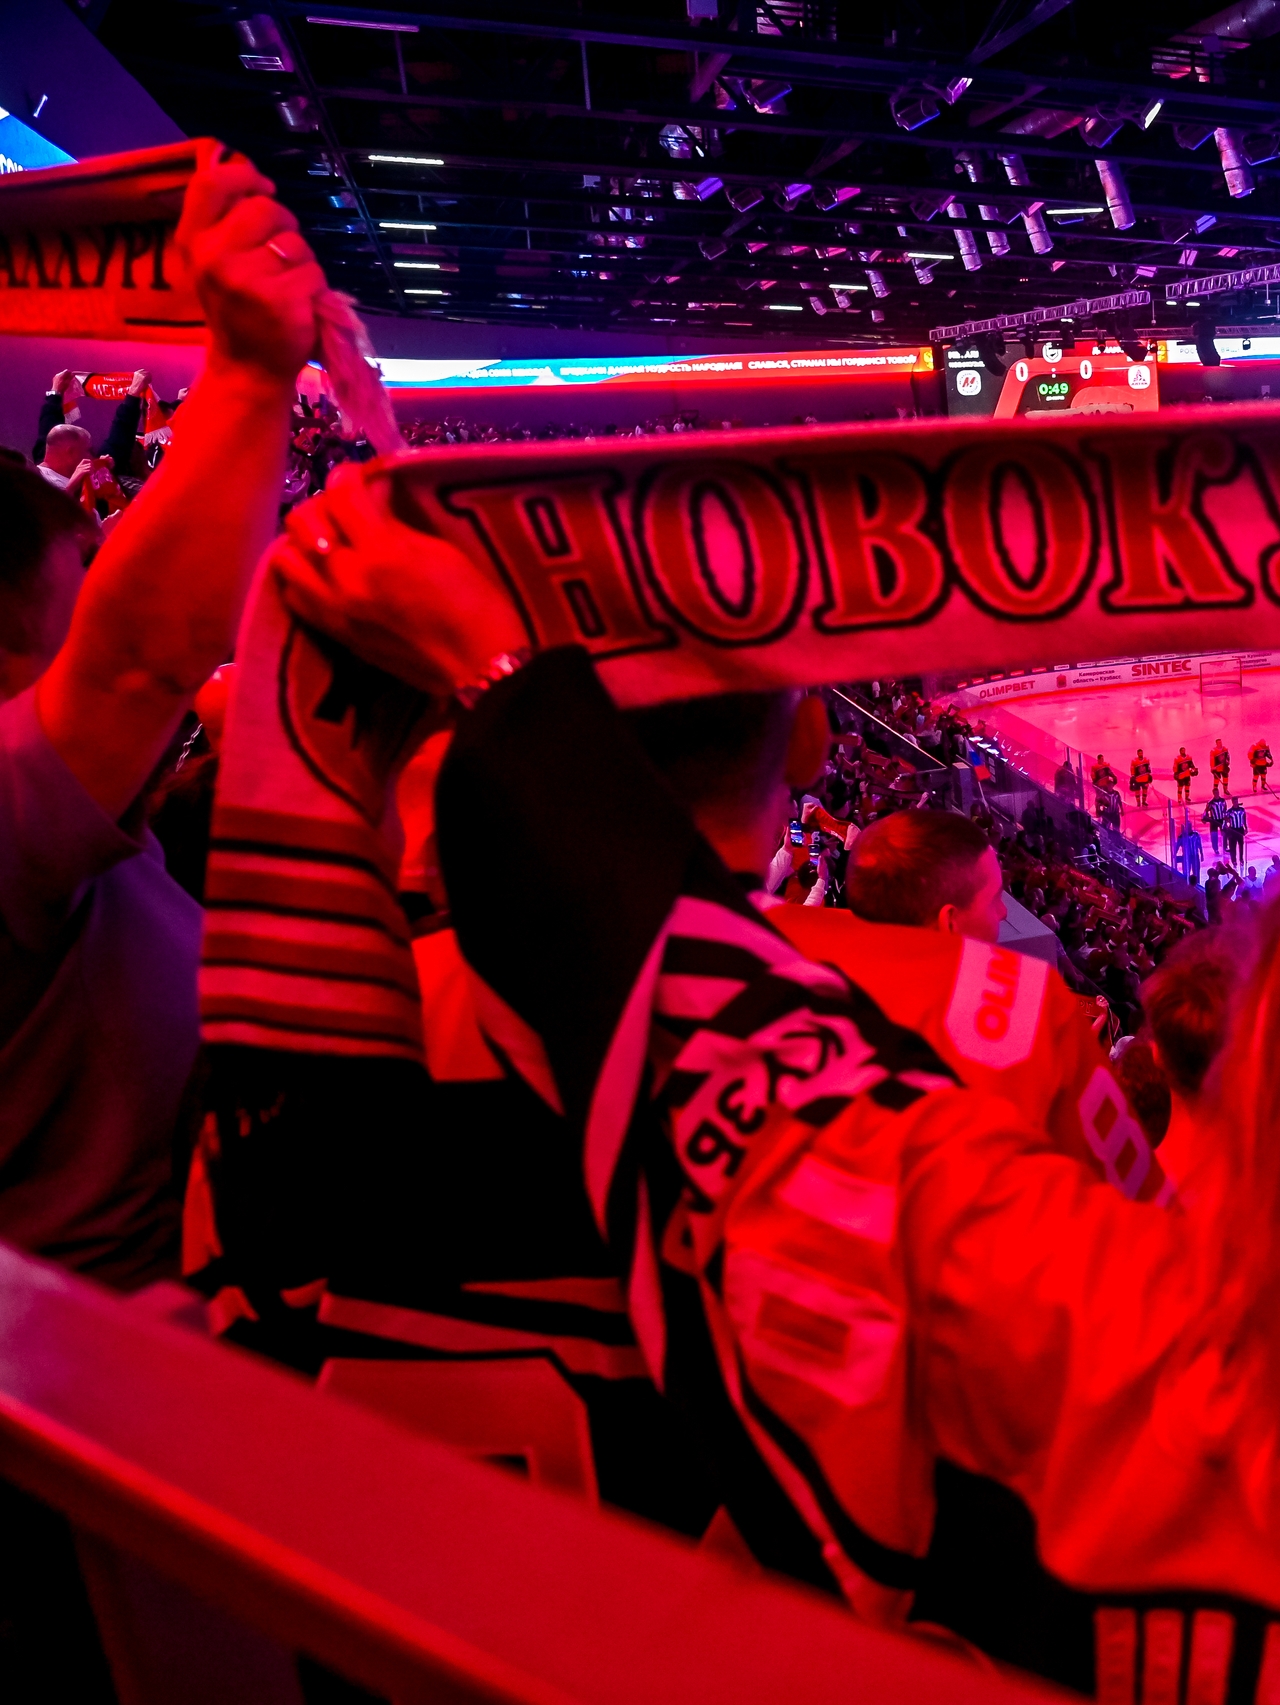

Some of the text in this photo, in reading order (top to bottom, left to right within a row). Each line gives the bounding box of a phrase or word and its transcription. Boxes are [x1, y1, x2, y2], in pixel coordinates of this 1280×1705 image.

[1015, 359, 1093, 382] 0 0
[1038, 382, 1069, 396] 0:49
[1131, 659, 1192, 677] SINTEC
[979, 680, 1036, 699] OLIMPBET
